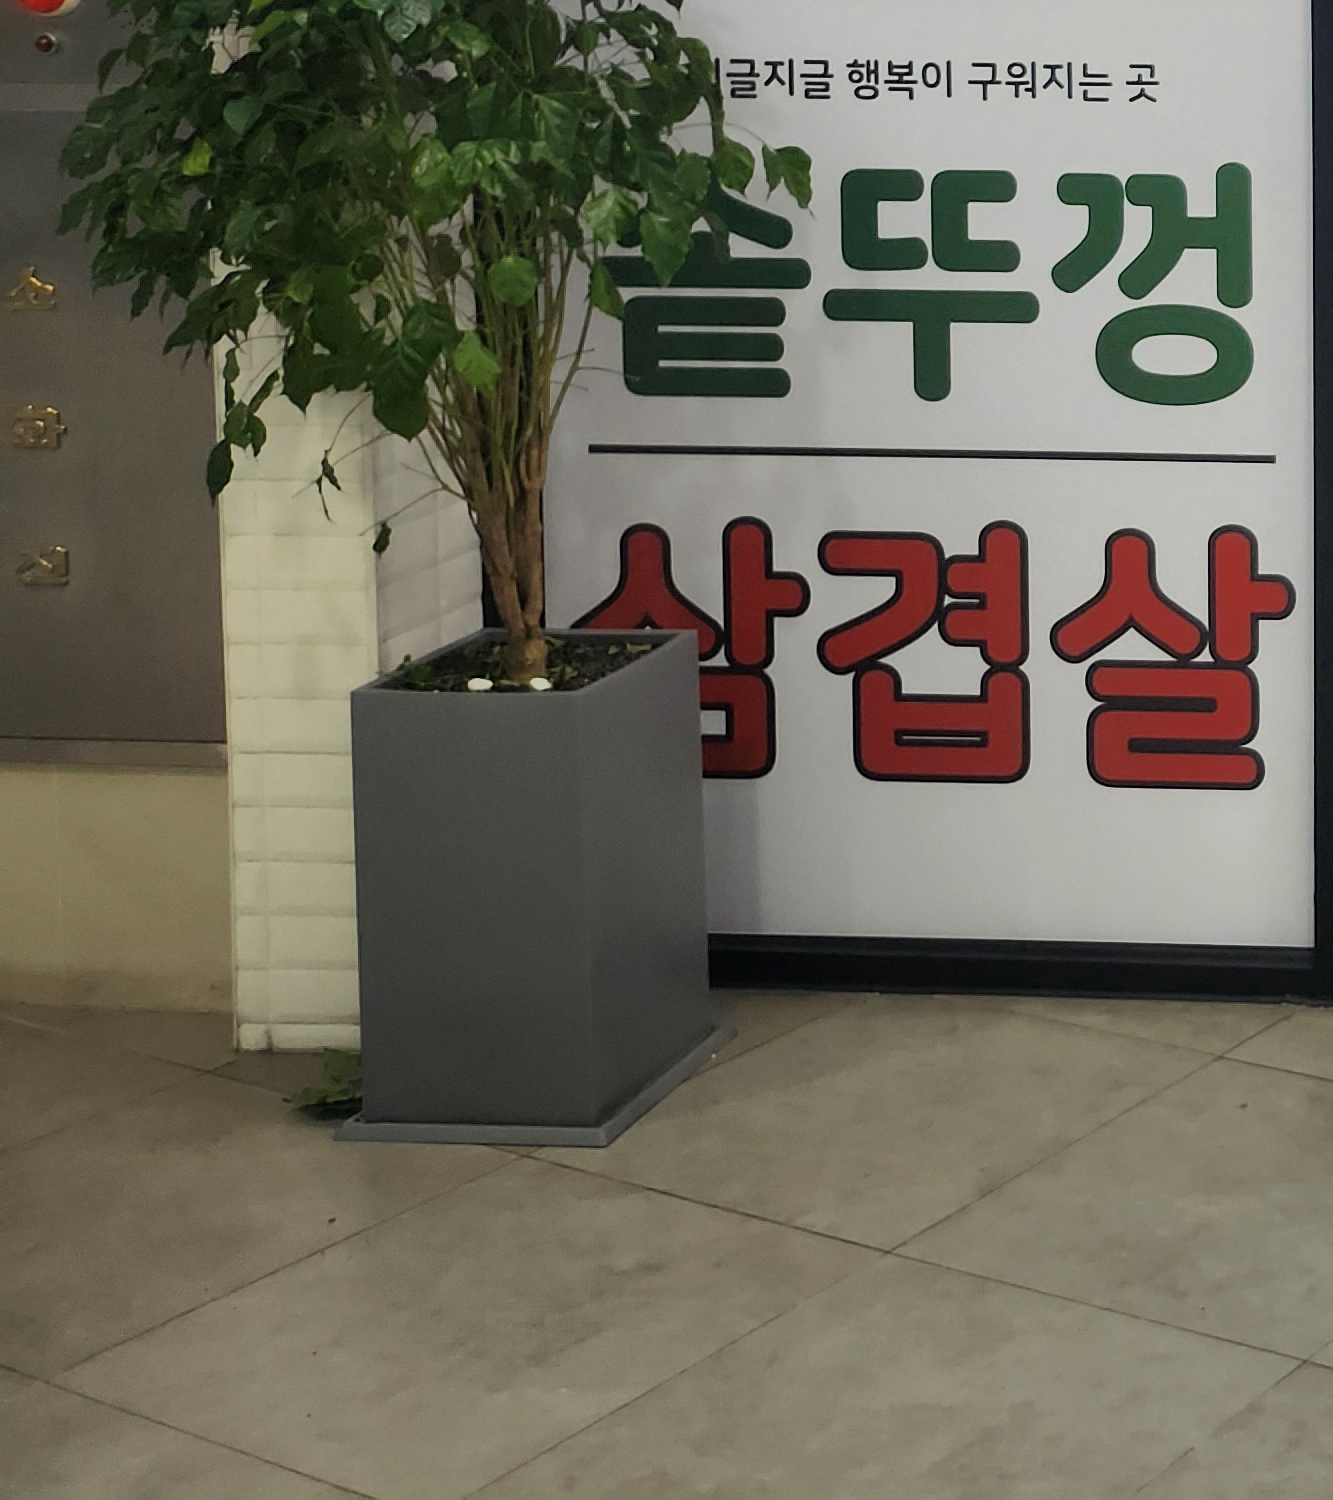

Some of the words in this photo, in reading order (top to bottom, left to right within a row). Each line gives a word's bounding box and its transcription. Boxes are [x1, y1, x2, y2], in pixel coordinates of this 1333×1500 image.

[846, 59, 953, 100] 행복이
[966, 62, 1112, 103] 구워지는
[1124, 63, 1161, 104] 곳
[597, 161, 1255, 406] 솥뚜껑
[570, 516, 1297, 790] 삼겹살
